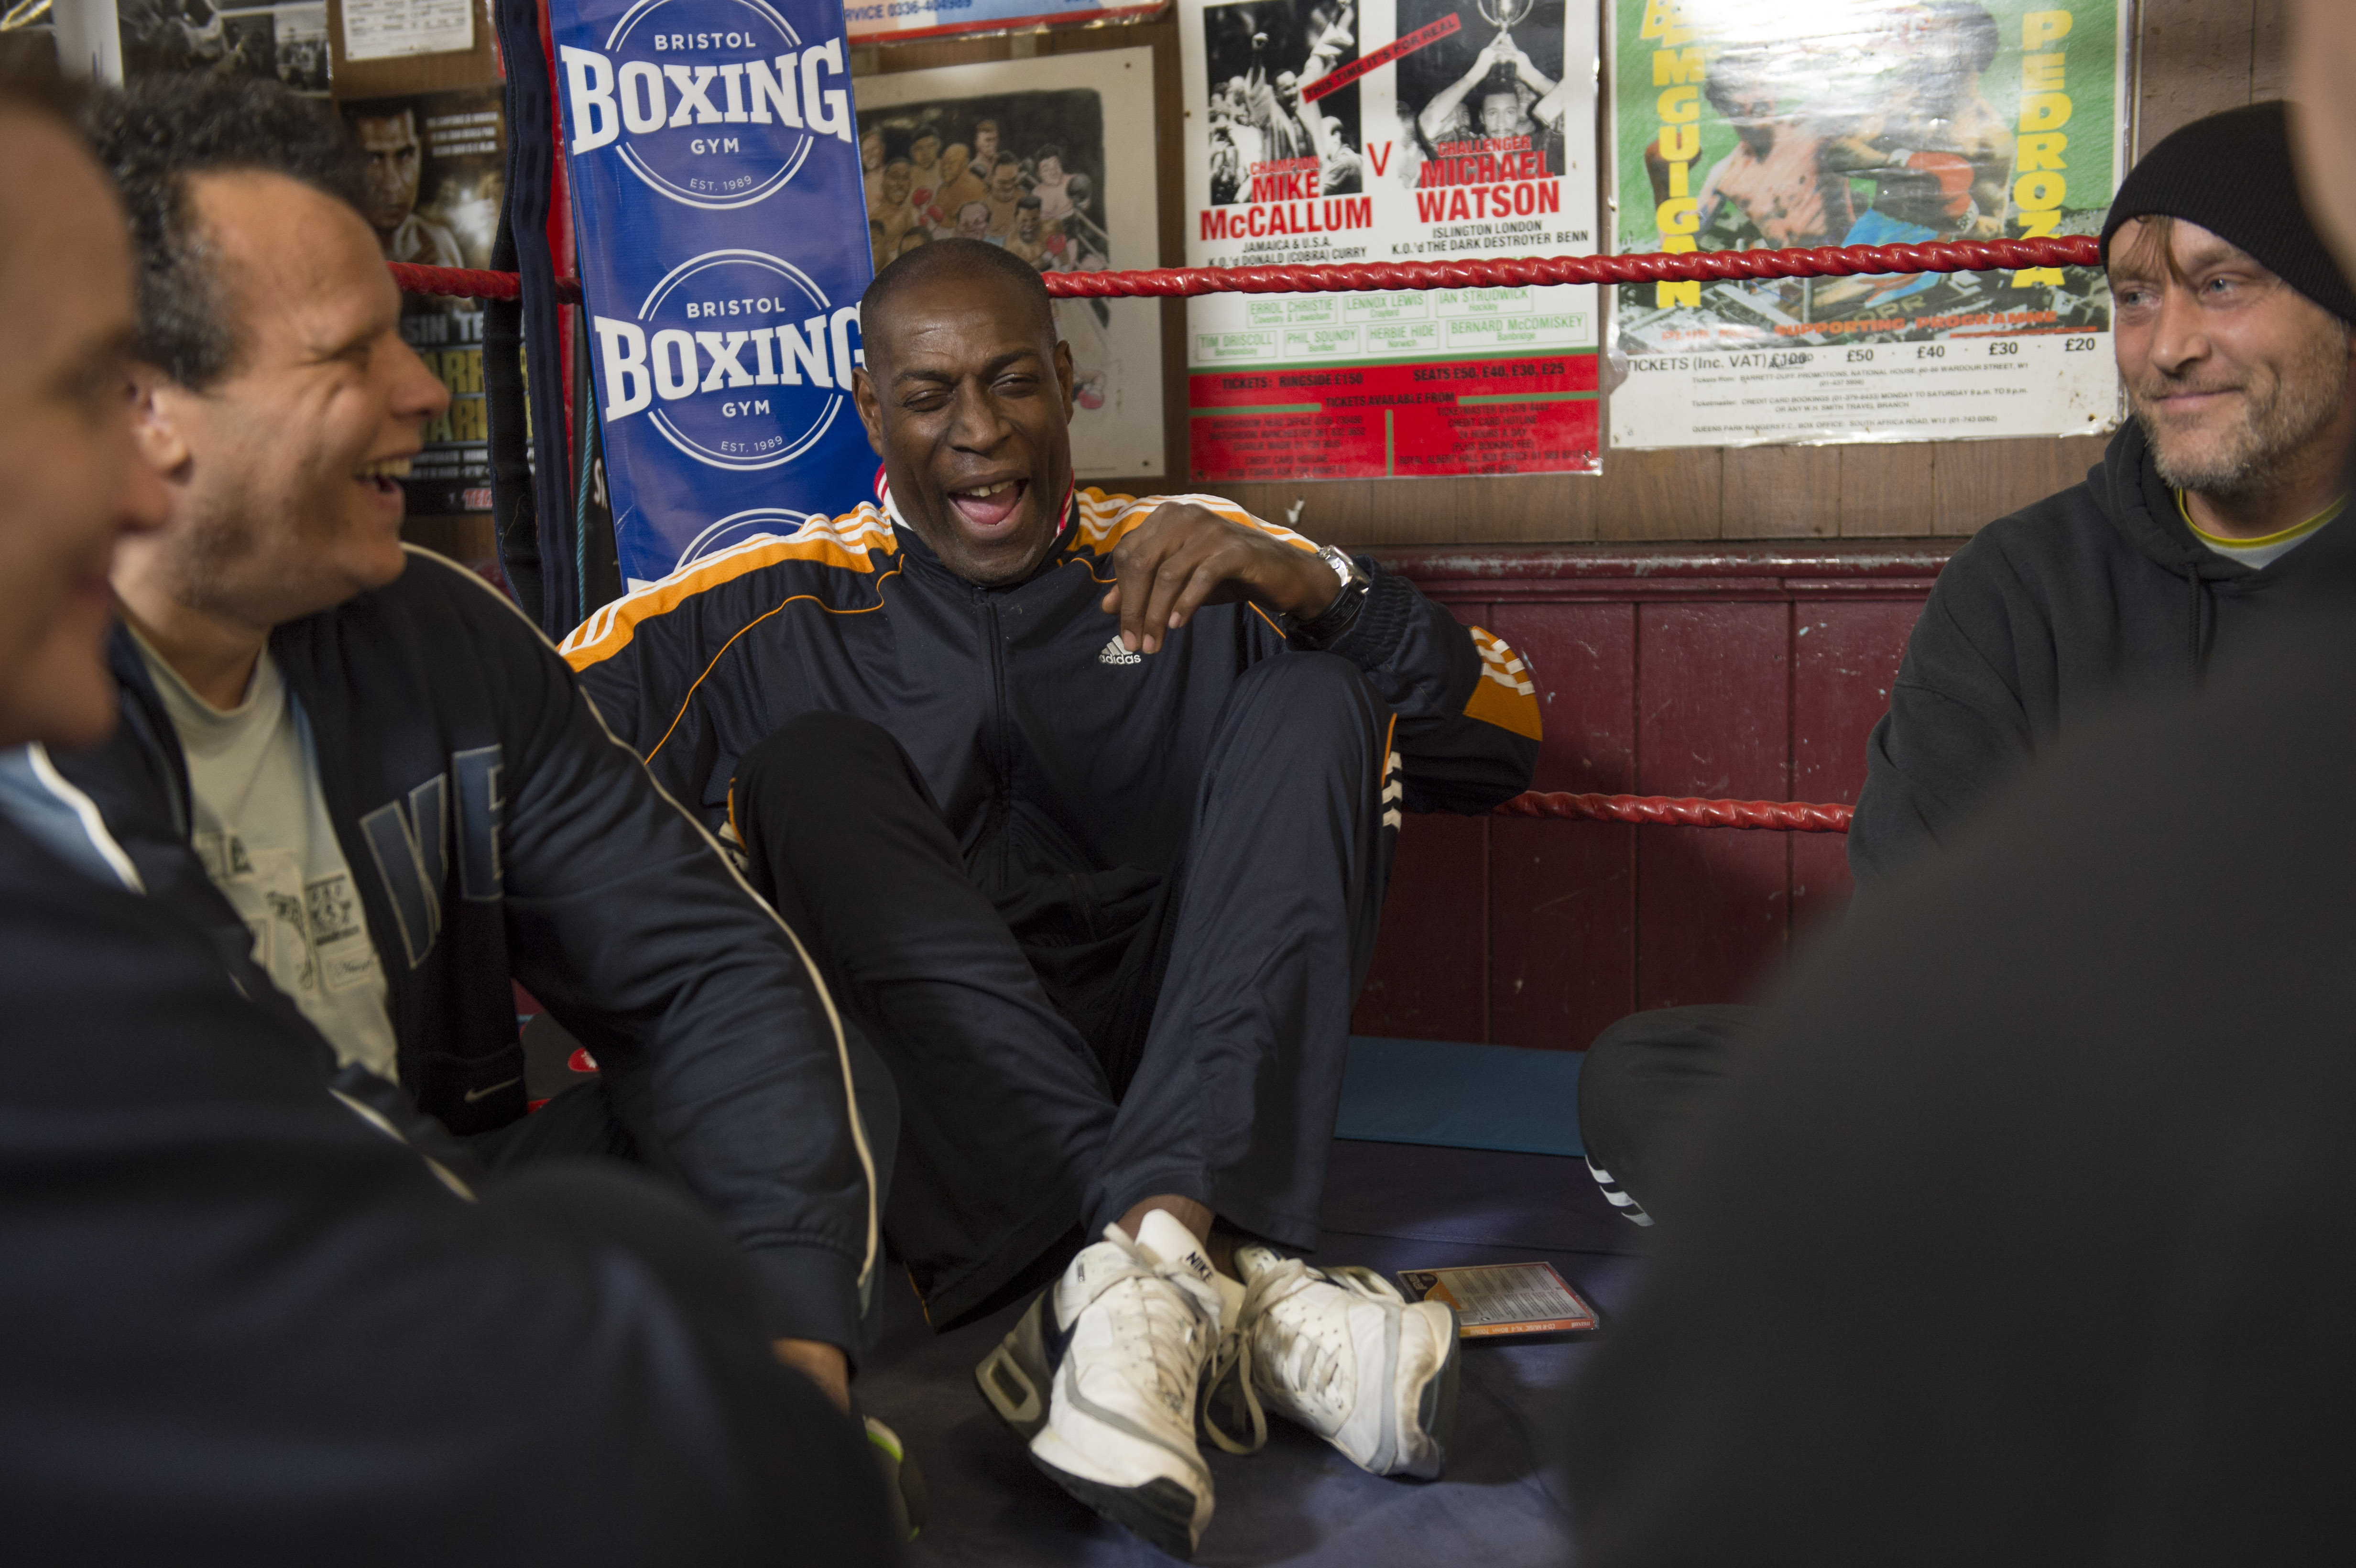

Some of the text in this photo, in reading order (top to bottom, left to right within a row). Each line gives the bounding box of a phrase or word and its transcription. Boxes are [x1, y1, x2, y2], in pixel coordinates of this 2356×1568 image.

[655, 32, 756, 50] BRISTOL
[1306, 79, 1333, 98] THIS
[1335, 63, 1363, 83] TIME
[1393, 36, 1420, 53] FOR
[1422, 20, 1455, 40] REAL
[560, 37, 852, 155] BOXING
[691, 138, 740, 154] GYM
[1437, 134, 1532, 157] CHALLENGER
[2011, 10, 2072, 288] PEDROZA
[1250, 155, 1320, 175] CHAMPION
[1367, 141, 1392, 176] V
[1420, 151, 1554, 188] MICHAEL
[690, 175, 752, 191] EST. 1989
[1252, 171, 1320, 204] MIKE
[1416, 180, 1560, 223] WATSON
[1200, 196, 1372, 240] McCALLUM
[1433, 220, 1541, 238] ISLINGTON LONDON
[1242, 240, 1290, 252] JAMAICA
[1292, 238, 1299, 250] &
[1426, 240, 1447, 251] THE
[1449, 238, 1481, 250] DARK
[1483, 233, 1551, 248] DESTROYER
[1555, 230, 1589, 243] BENN
[1242, 253, 1284, 265] DONALD
[1331, 246, 1367, 260] CURRY
[1347, 293, 1423, 310] LENNOX LEWIS
[1439, 287, 1529, 304] IAN STRUDWICK
[687, 297, 785, 319] BRISTOL
[1249, 298, 1333, 315] ERROL CHRISTIE
[1370, 324, 1435, 339] HERBIE HIDE
[1451, 315, 1582, 334] BERNARD McCOMISKEY
[1774, 317, 1905, 337] SUPPORTING
[1915, 310, 2057, 329] PROGRAMME
[1200, 333, 1273, 348] TIM DRISCOLL
[1287, 332, 1310, 344] PHIL
[594, 301, 866, 422] BOXING
[1627, 358, 1689, 371] TICKETS
[1693, 357, 1724, 371] (Inc.
[1729, 354, 1767, 369] VAT)
[1847, 348, 1874, 362] £50
[1917, 345, 1945, 359] £40
[1989, 341, 2018, 356] £30
[2064, 338, 2096, 352] £20
[1278, 374, 1332, 387] RINGSIDE
[1333, 372, 1363, 385] £150
[1413, 368, 1450, 381] SEATS
[722, 400, 770, 417] GYM
[1325, 392, 1454, 407] TICKETS AVAILABLE FROM
[721, 436, 783, 453] EST. 1989
[1099, 653, 1142, 665] adidas
[1186, 1251, 1214, 1282] NIKE
